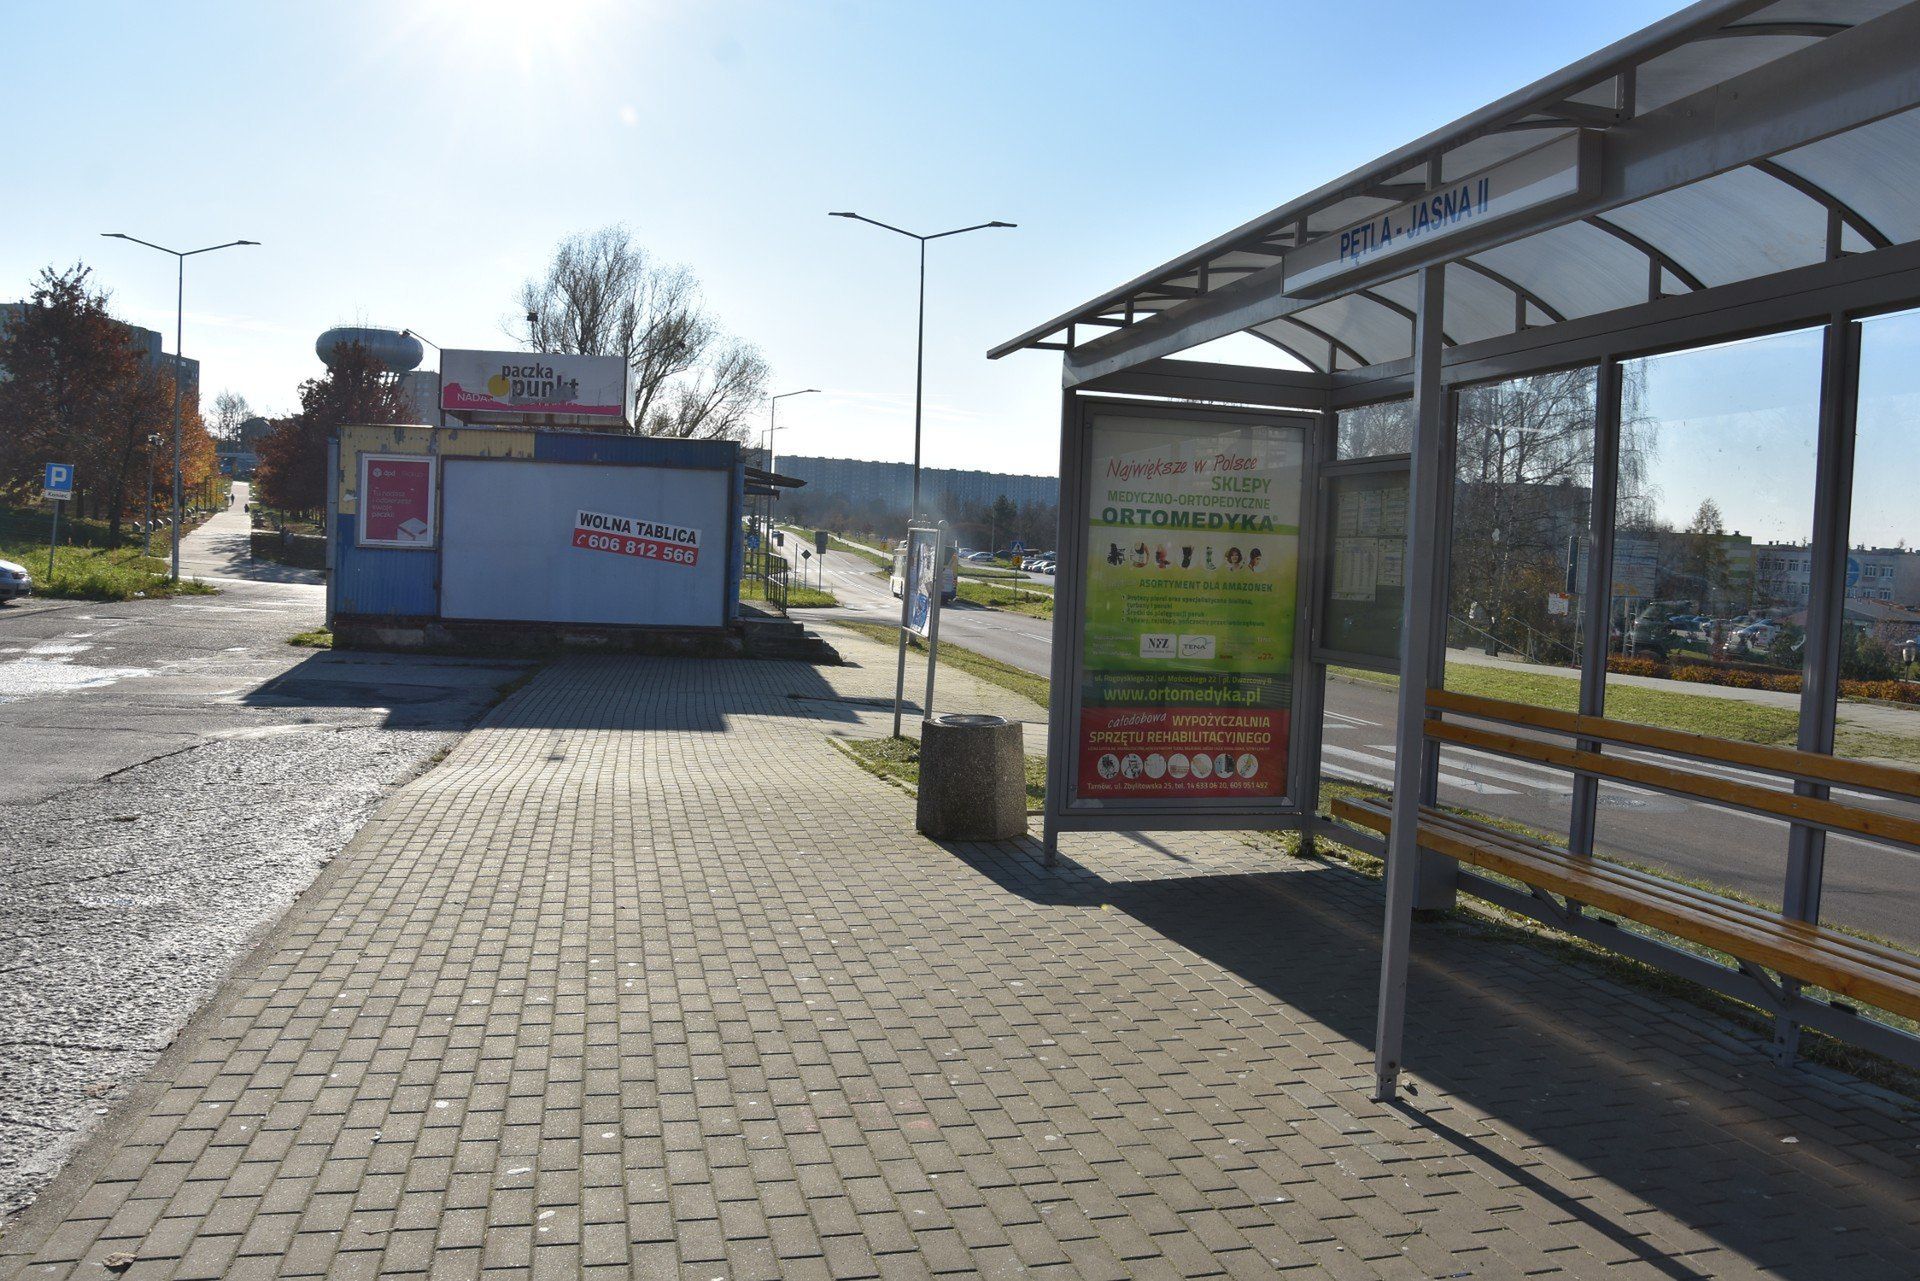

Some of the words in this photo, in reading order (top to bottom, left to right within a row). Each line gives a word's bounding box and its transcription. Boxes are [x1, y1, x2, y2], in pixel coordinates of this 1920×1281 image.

[1340, 216, 1392, 266] PĘTLA
[1407, 185, 1472, 239] JASNA
[1477, 177, 1489, 214] II
[502, 363, 554, 381] paczka
[1106, 457, 1187, 481] Największe
[1194, 459, 1208, 474] w
[1213, 453, 1258, 472] Polsce
[51, 466, 67, 487] P
[1211, 476, 1272, 494] SKLEPY
[1107, 490, 1270, 510] MEDYCZNO-ORTOPEDYCZNE
[580, 512, 631, 533] WOLNA
[636, 522, 697, 544] TABLICA
[588, 535, 620, 551] 606
[625, 541, 657, 558] 812
[663, 546, 694, 564] 566
[1139, 578, 1200, 590] ASORTYMENT
[1203, 580, 1220, 590] DLA
[1222, 581, 1273, 592] AMAZONEK
[1149, 638, 1169, 649] NFZ
[1104, 687, 1261, 705] www.ortomedyka.pl
[1107, 713, 1167, 729] całodobowa
[1172, 713, 1271, 728] WYPOŻYCZALNIA
[1089, 731, 1144, 745] SPRZĘTU
[1147, 732, 1271, 744] REHABILITACYJNEGO
